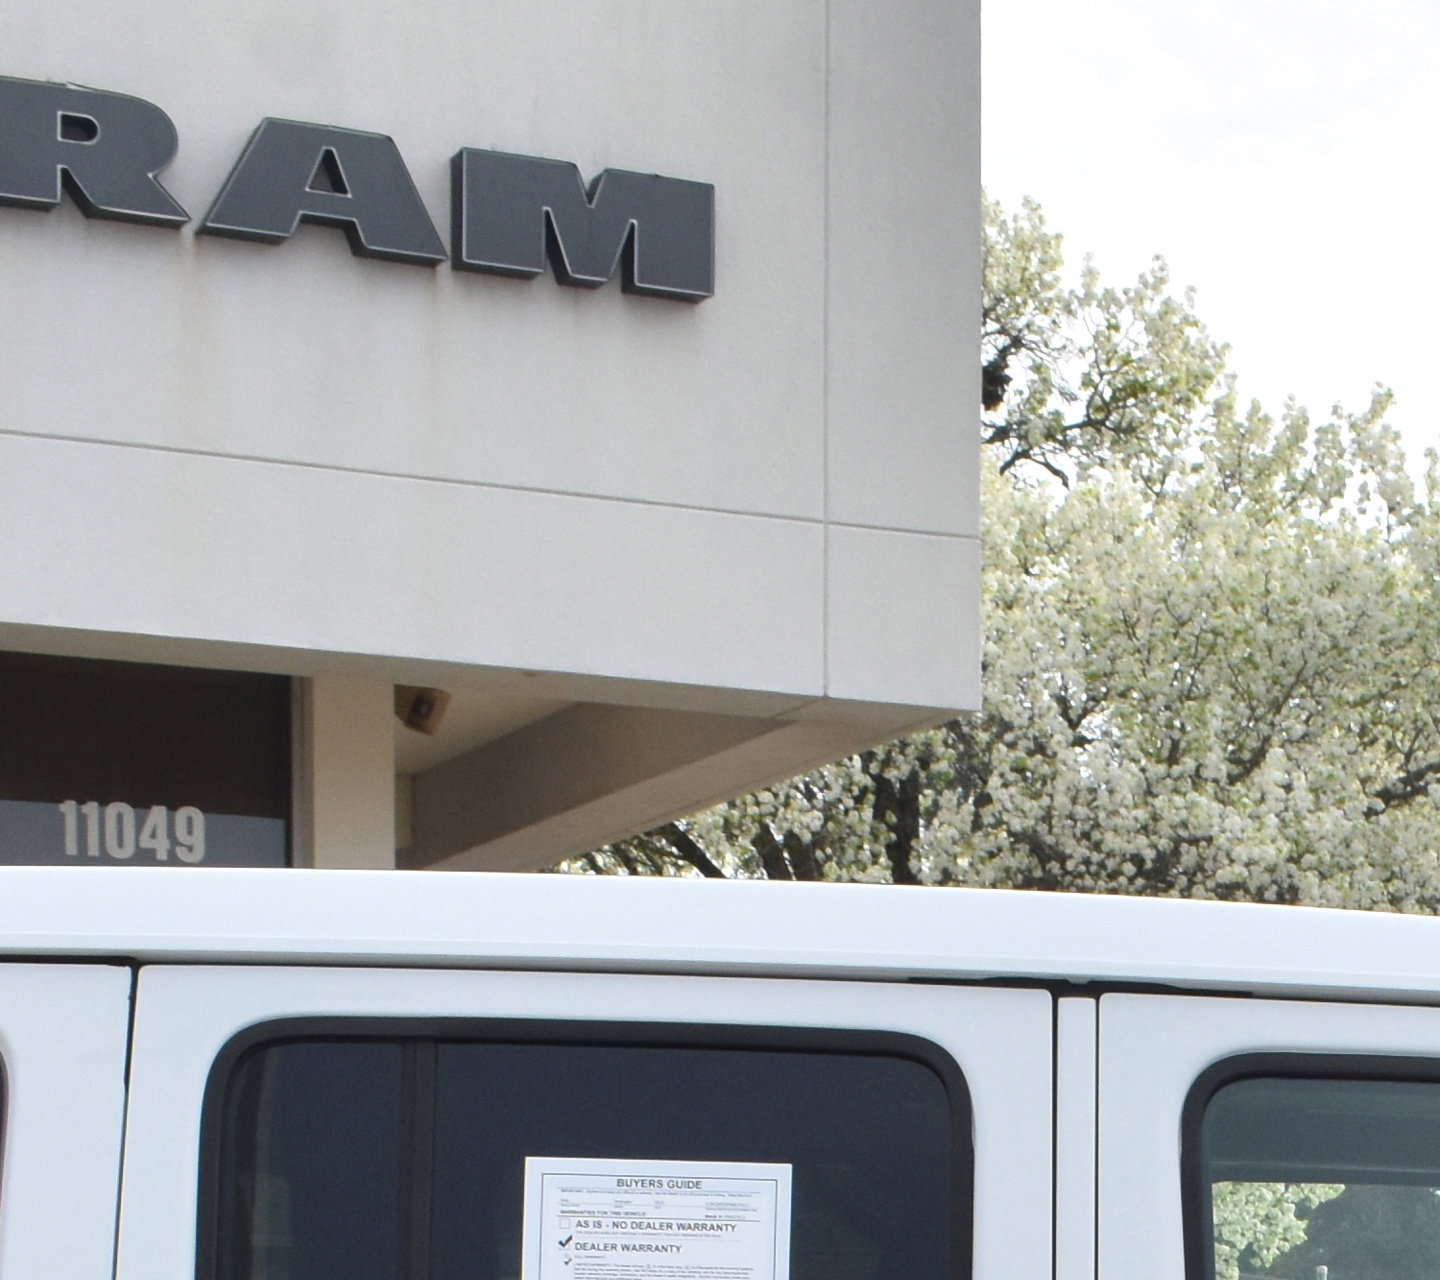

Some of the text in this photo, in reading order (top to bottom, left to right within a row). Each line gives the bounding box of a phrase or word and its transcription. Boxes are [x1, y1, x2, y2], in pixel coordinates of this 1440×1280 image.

[60, 800, 206, 864] 11049
[616, 1178, 703, 1190] BUYERS GUIDE
[575, 1220, 590, 1230] AS
[592, 1221, 603, 1230] IS
[612, 1221, 628, 1230] NO
[630, 1221, 674, 1231] DEALER
[676, 1222, 737, 1233] WARRANTY
[574, 1243, 682, 1254] DEALER WARRANTY
